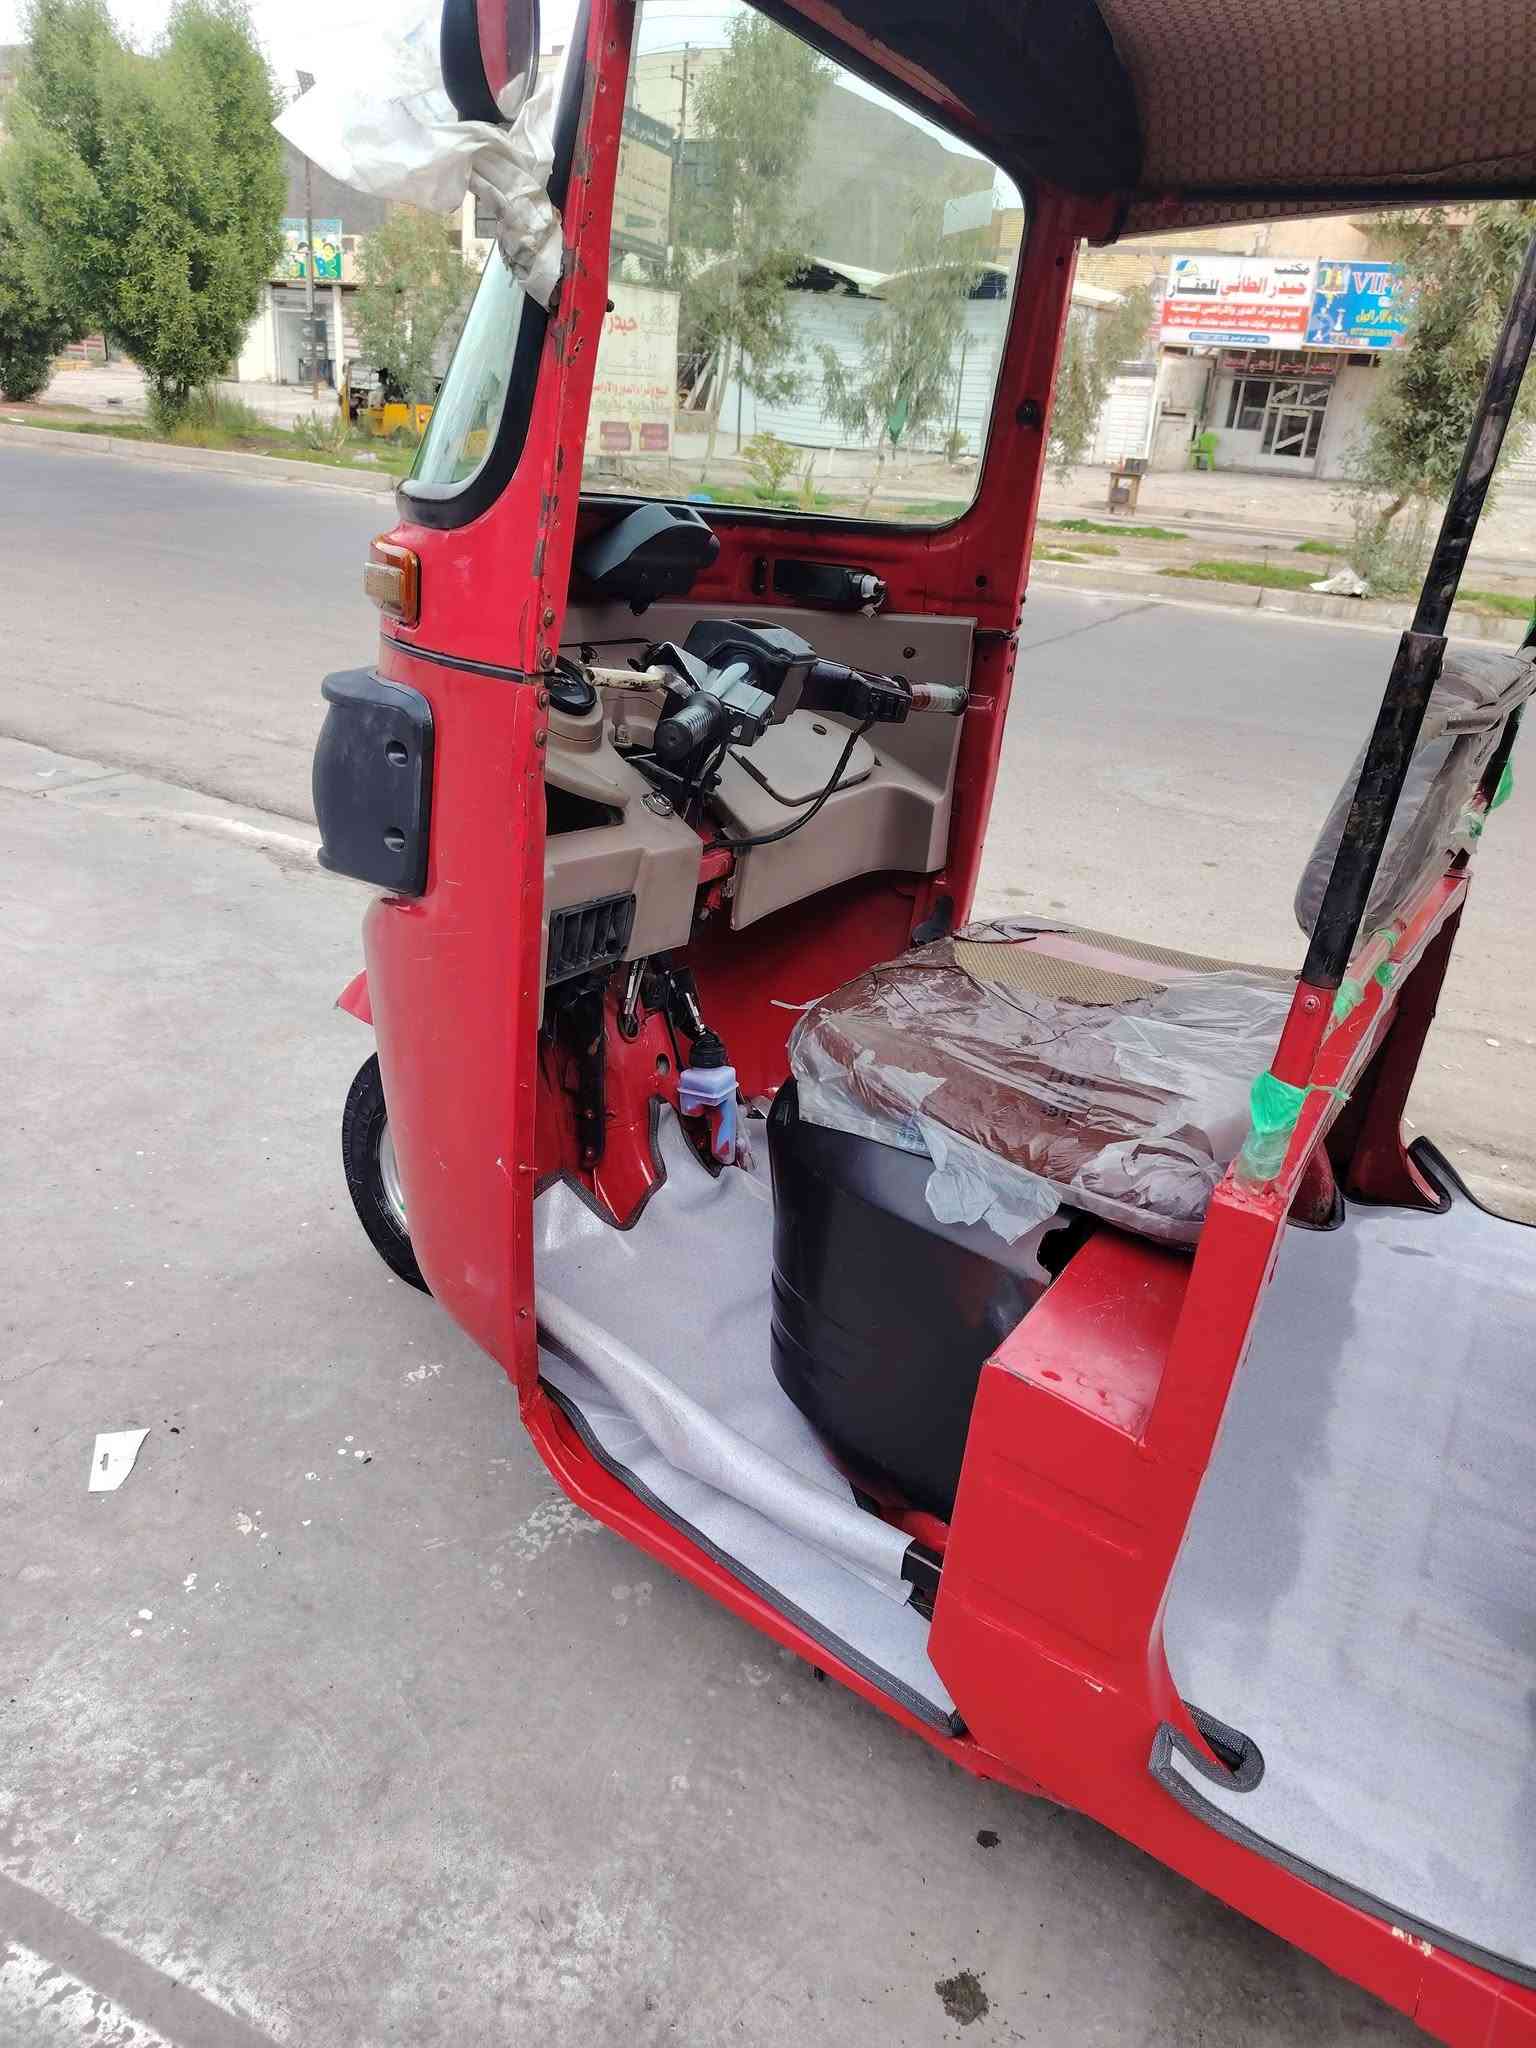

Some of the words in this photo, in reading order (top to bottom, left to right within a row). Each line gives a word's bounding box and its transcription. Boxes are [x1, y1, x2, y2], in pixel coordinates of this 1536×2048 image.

[1274, 263, 1311, 276] مكتب
[1220, 275, 1267, 299] الطائي
[1268, 282, 1307, 299] حيدر
[606, 315, 638, 336] حيدر
